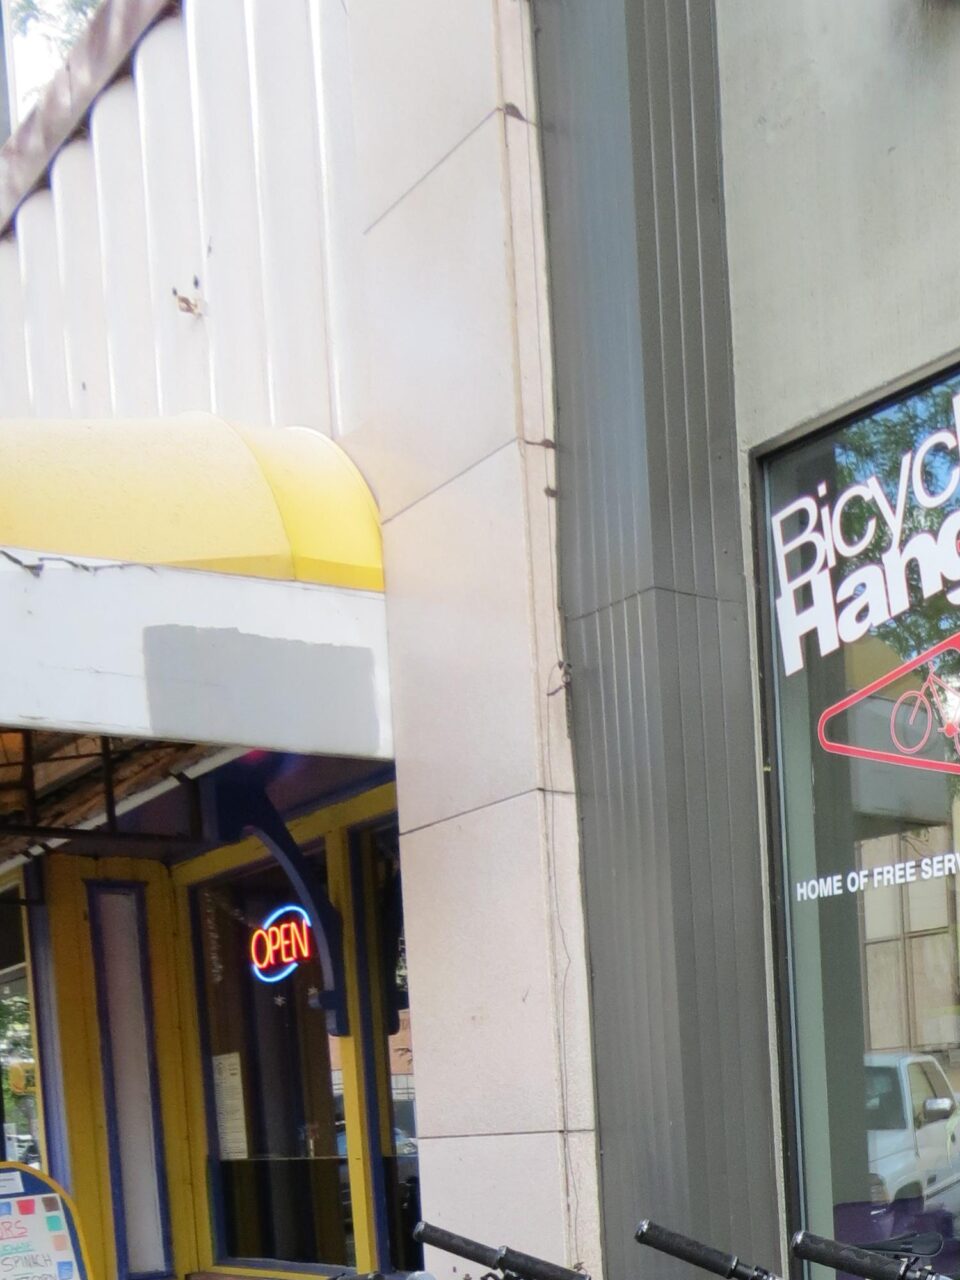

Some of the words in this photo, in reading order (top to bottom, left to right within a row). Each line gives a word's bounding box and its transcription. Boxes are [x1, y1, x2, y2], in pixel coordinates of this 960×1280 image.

[796, 874, 843, 901] HOME
[847, 868, 869, 893] OF
[873, 860, 917, 888] FREE
[251, 919, 309, 969] OPEN
